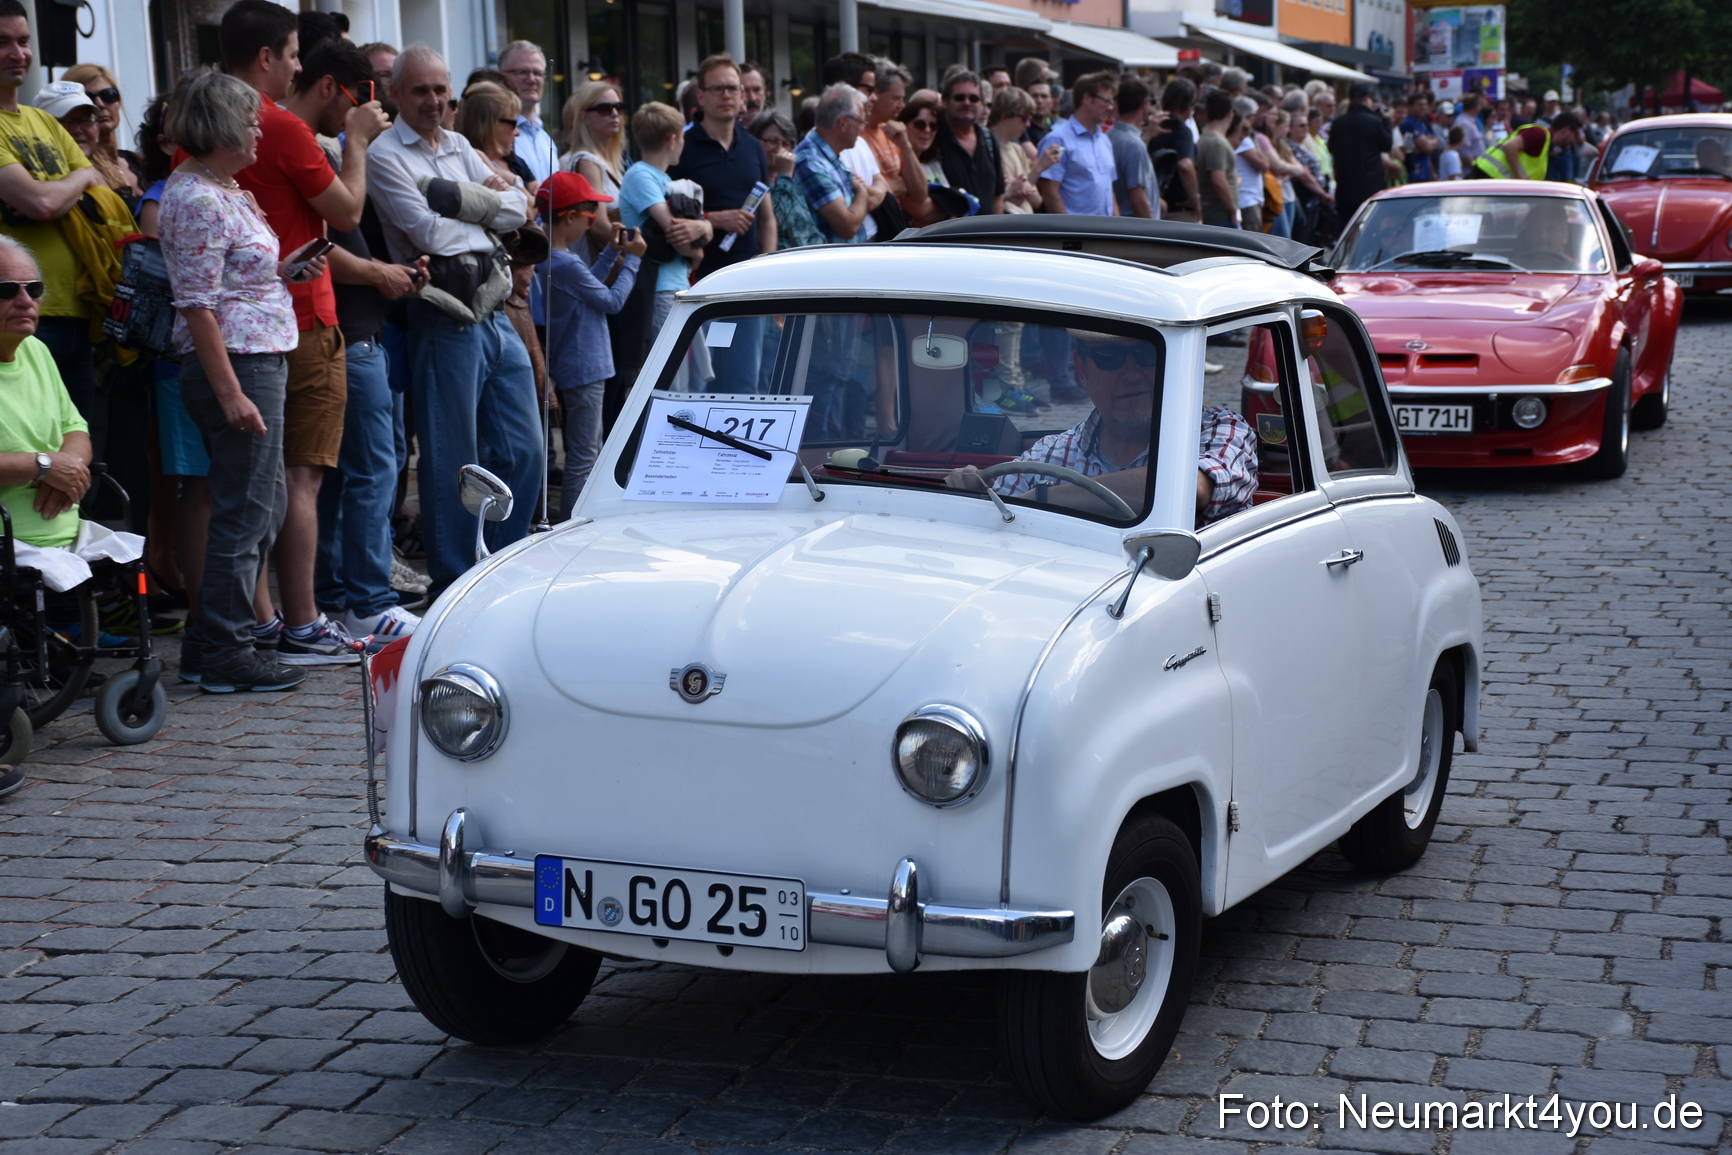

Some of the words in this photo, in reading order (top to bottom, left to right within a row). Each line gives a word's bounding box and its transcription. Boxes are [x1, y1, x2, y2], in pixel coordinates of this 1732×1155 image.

[1396, 407, 1424, 428] GT
[1427, 408, 1469, 429] 71H
[723, 416, 777, 441] 217
[544, 897, 555, 912] D
[564, 867, 593, 920] N
[629, 875, 692, 931] GO
[707, 883, 767, 937] 25
[778, 890, 799, 906] 03
[780, 925, 799, 941] 10
